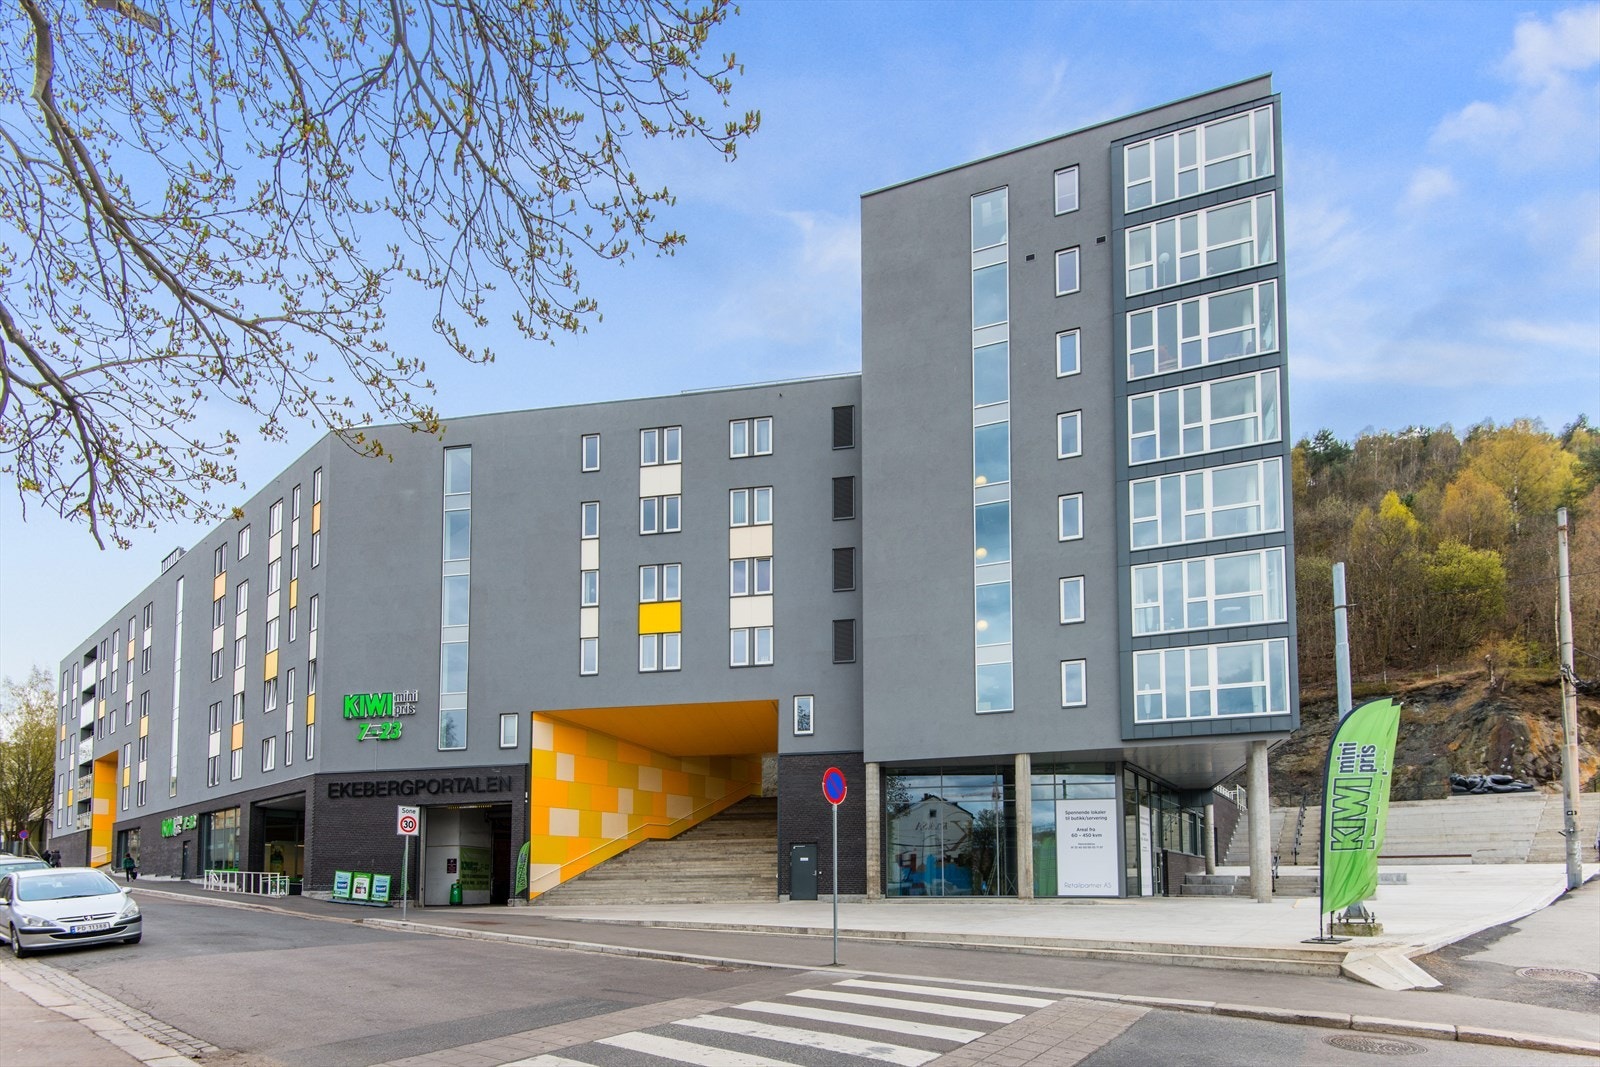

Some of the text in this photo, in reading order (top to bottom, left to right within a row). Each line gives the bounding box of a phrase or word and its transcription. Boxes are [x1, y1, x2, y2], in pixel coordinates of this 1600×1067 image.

[343, 692, 394, 719] KIWI
[395, 690, 419, 702] mini
[395, 703, 416, 718] pris
[1337, 742, 1358, 774] mini
[1357, 744, 1377, 775] pris
[328, 776, 512, 799] EKEBERGPORTALEN
[401, 807, 416, 815] Sone
[1331, 777, 1373, 851] KIWI
[403, 820, 414, 829] 30
